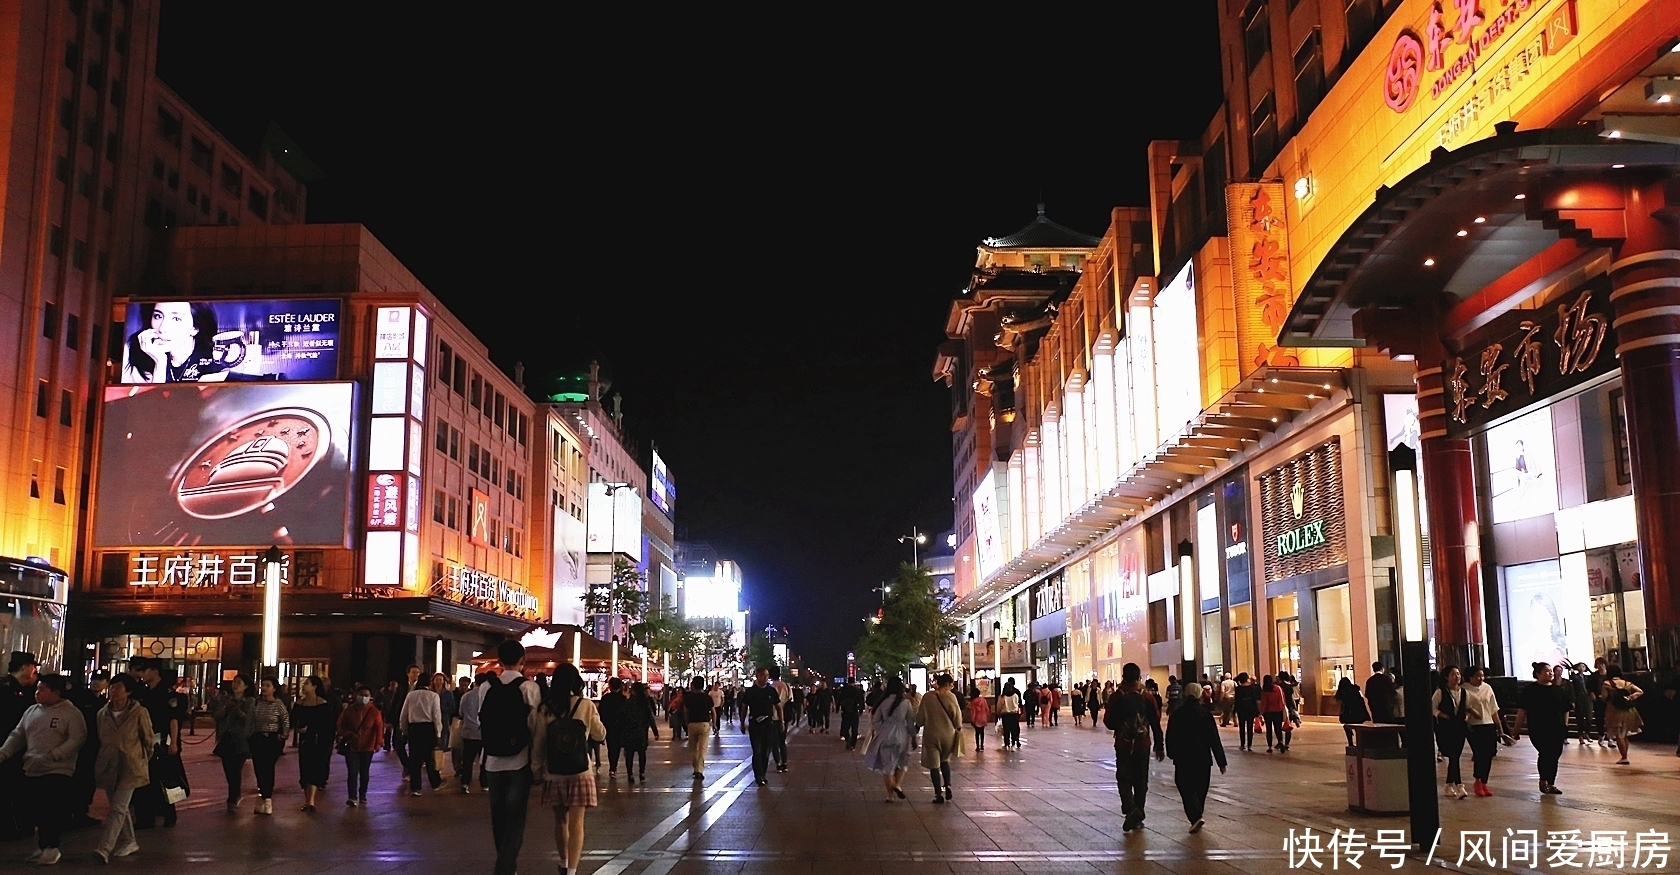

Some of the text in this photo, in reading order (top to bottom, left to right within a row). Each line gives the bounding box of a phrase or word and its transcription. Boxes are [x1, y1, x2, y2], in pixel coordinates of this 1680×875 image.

[1431, 40, 1481, 100] DONGAN
[298, 313, 335, 323] LAUDER
[1277, 519, 1326, 557] ROLEX
[50, 717, 59, 728] E
